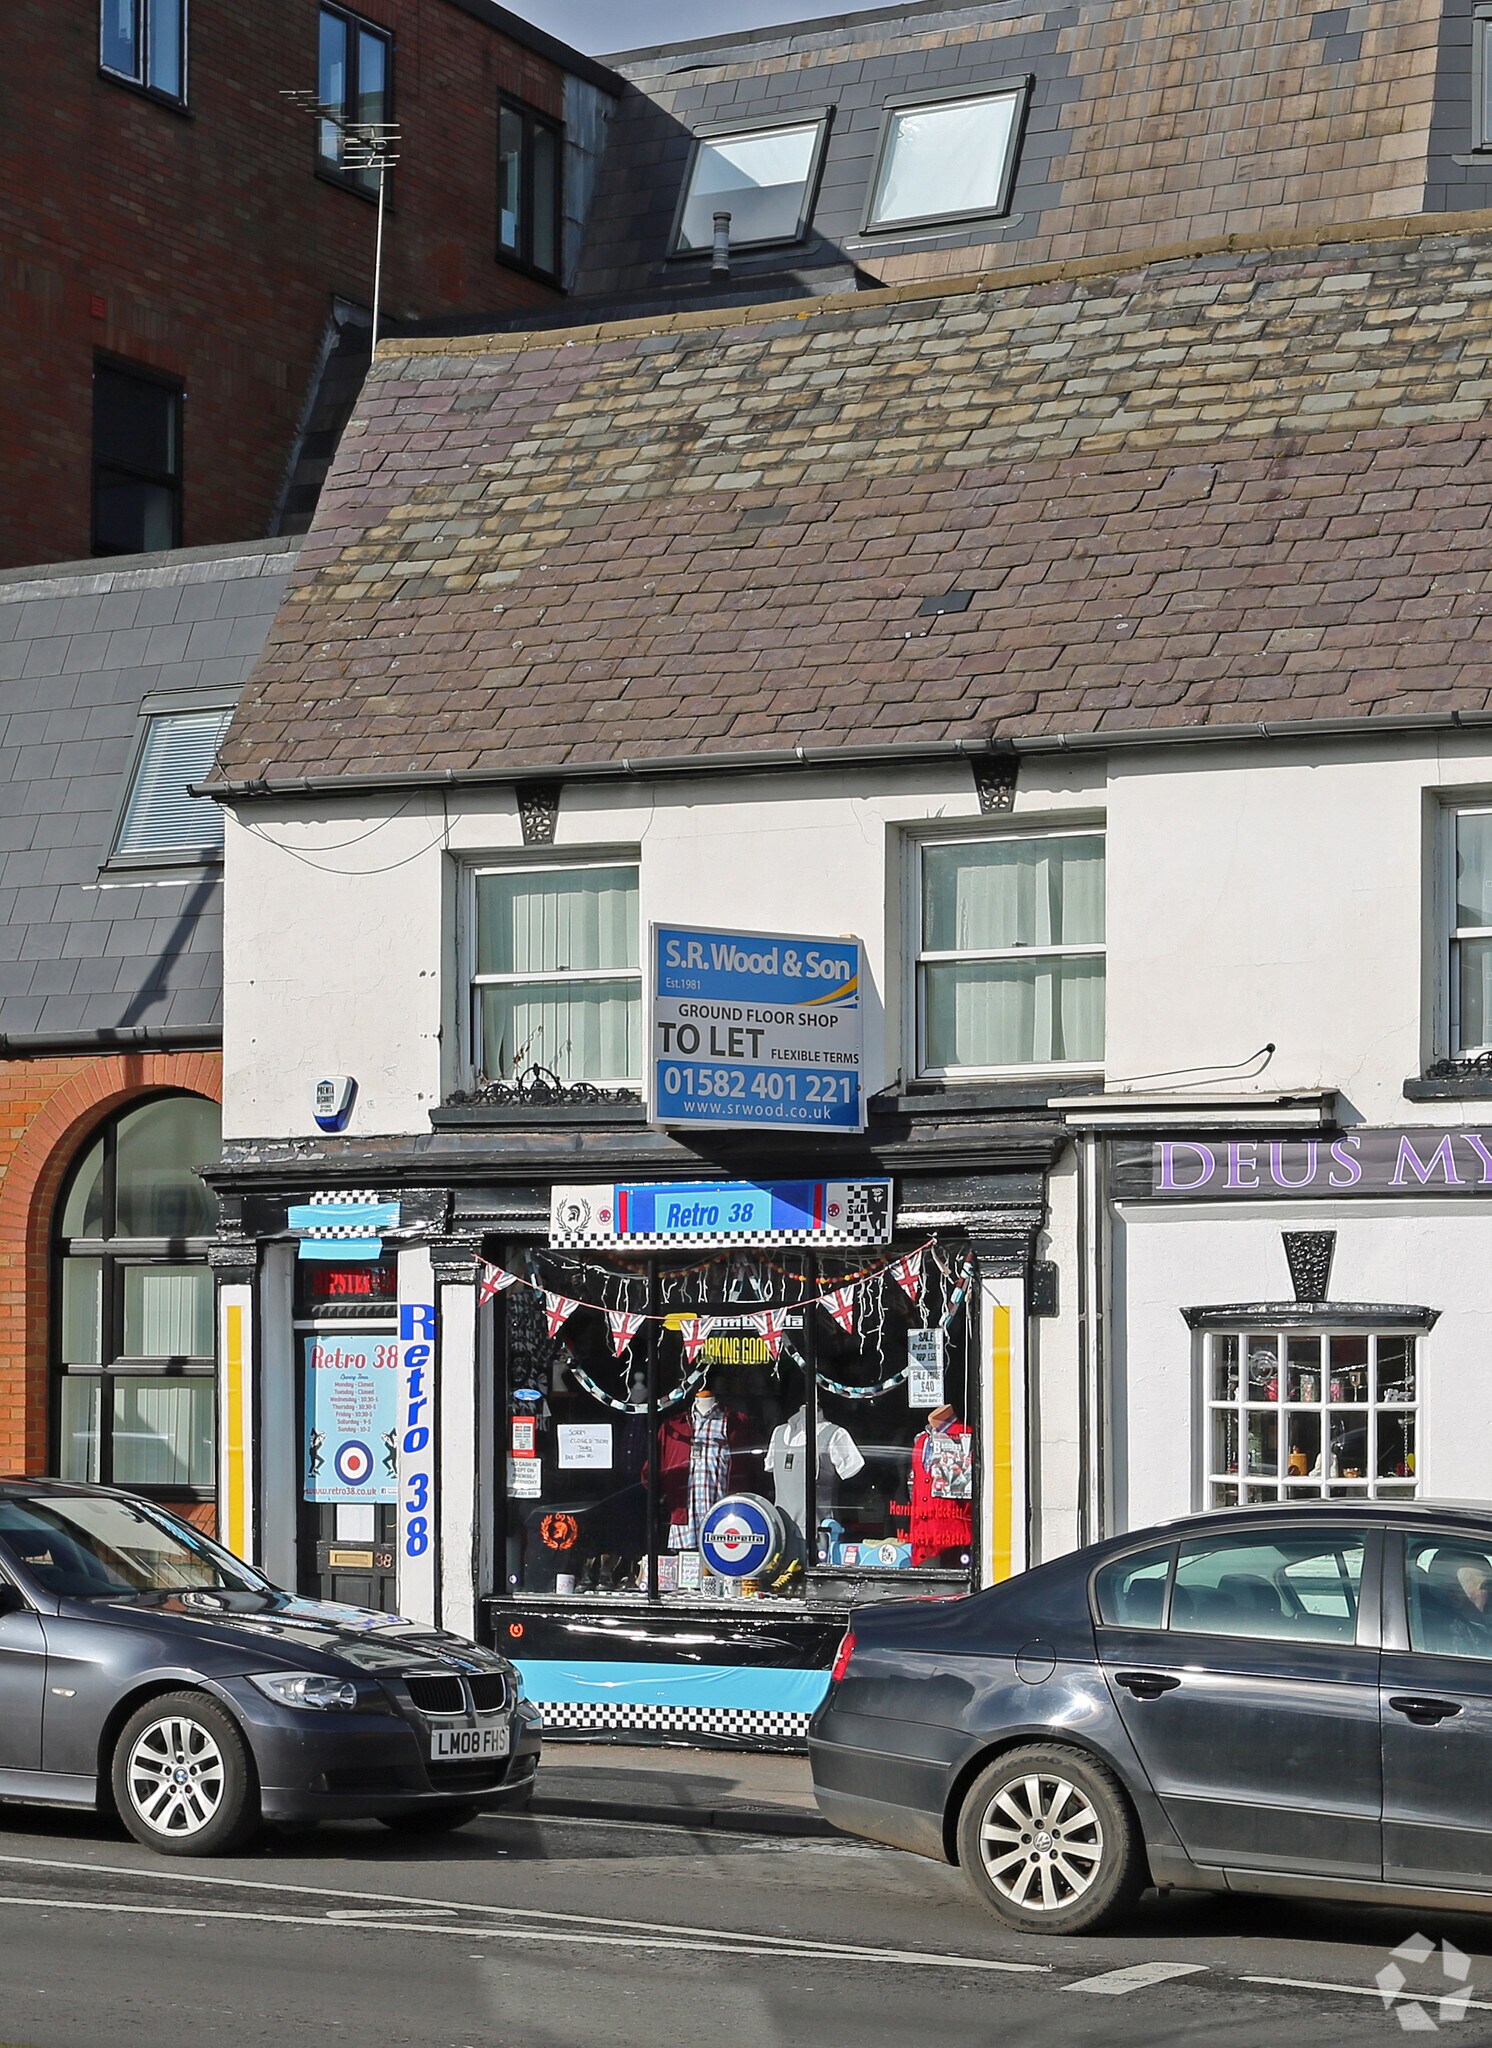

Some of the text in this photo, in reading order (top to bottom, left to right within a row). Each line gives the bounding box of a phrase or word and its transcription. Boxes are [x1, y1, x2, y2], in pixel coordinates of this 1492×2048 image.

[665, 939, 850, 980] S.R. Wood & Son
[665, 977, 701, 990] Est.1981
[678, 1003, 839, 1028] GROUND FLOOR SHOP
[657, 1022, 765, 1058] TO LET
[771, 1048, 859, 1064] FLEXIBLE TERMS
[664, 1066, 850, 1104] 01582 401 221
[683, 1100, 831, 1119] www.srwood.co.uk
[1155, 1136, 1363, 1190] DEUS
[666, 1202, 754, 1229] Retro 38
[310, 1344, 398, 1369] Retro 38
[920, 1380, 935, 1393] £40
[399, 1304, 437, 1557] Retro 38
[305, 1487, 377, 1496] www.retro38.co.uk
[375, 1553, 393, 1568] 38
[438, 1730, 505, 1755] LM08 FHS
